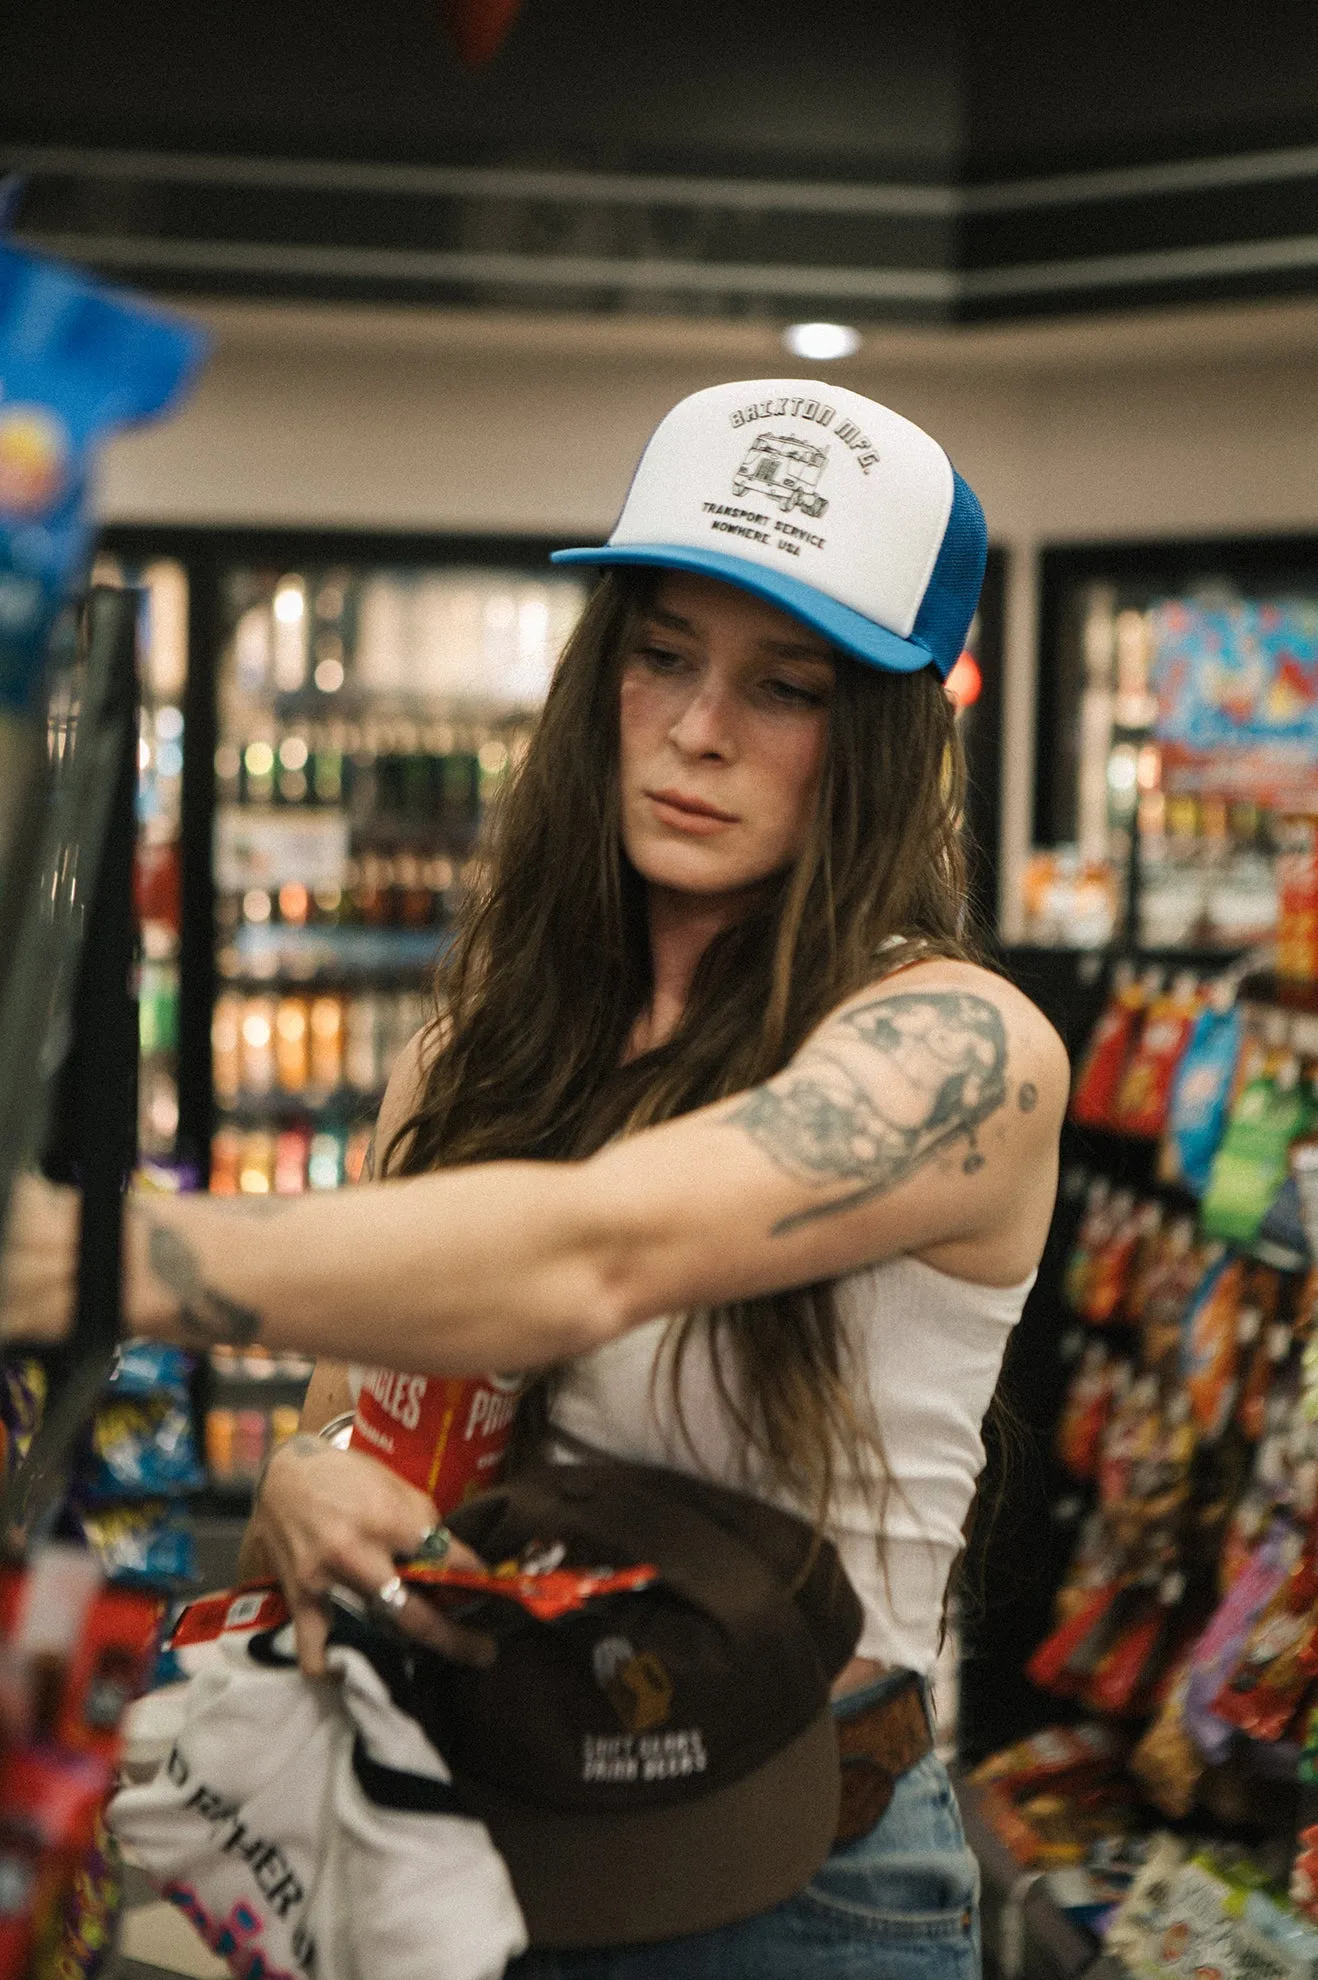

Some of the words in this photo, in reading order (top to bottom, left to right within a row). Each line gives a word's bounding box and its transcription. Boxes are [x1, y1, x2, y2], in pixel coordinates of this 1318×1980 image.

[729, 397, 836, 428] BRIXTON
[702, 502, 770, 526] TRANSPORT
[774, 520, 826, 550] SERVICE
[711, 520, 771, 545] NOWHERE
[778, 540, 801, 556] USA
